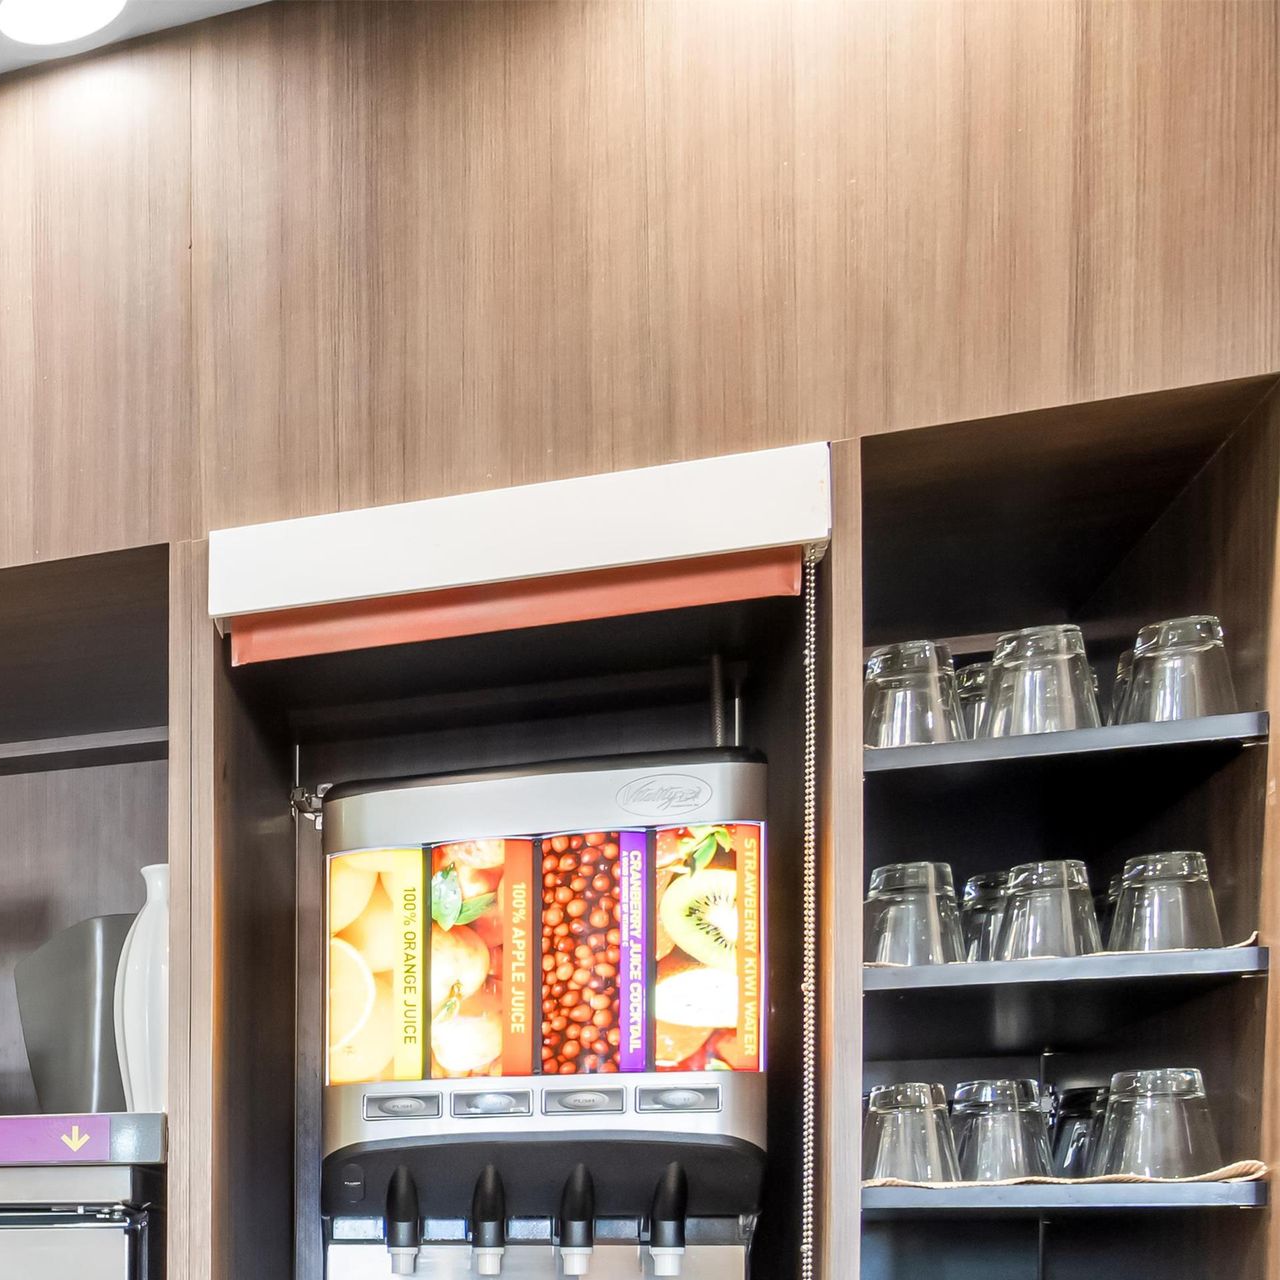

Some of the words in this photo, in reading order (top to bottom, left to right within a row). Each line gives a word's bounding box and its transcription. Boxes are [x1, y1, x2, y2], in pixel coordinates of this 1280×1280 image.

[403, 887, 416, 926] 100%
[512, 882, 526, 923] 100%
[629, 850, 642, 938] CRANBERRY
[744, 838, 757, 958] STRAWBERRY
[403, 930, 416, 995] ORANGE
[511, 928, 526, 983] APPLE
[629, 939, 642, 981] JUICE
[744, 961, 757, 996] KIWI
[403, 1001, 416, 1045] JUICE
[510, 989, 525, 1034] JUICE
[629, 982, 642, 1054] COCKTAIL
[744, 1000, 757, 1057] WATER
